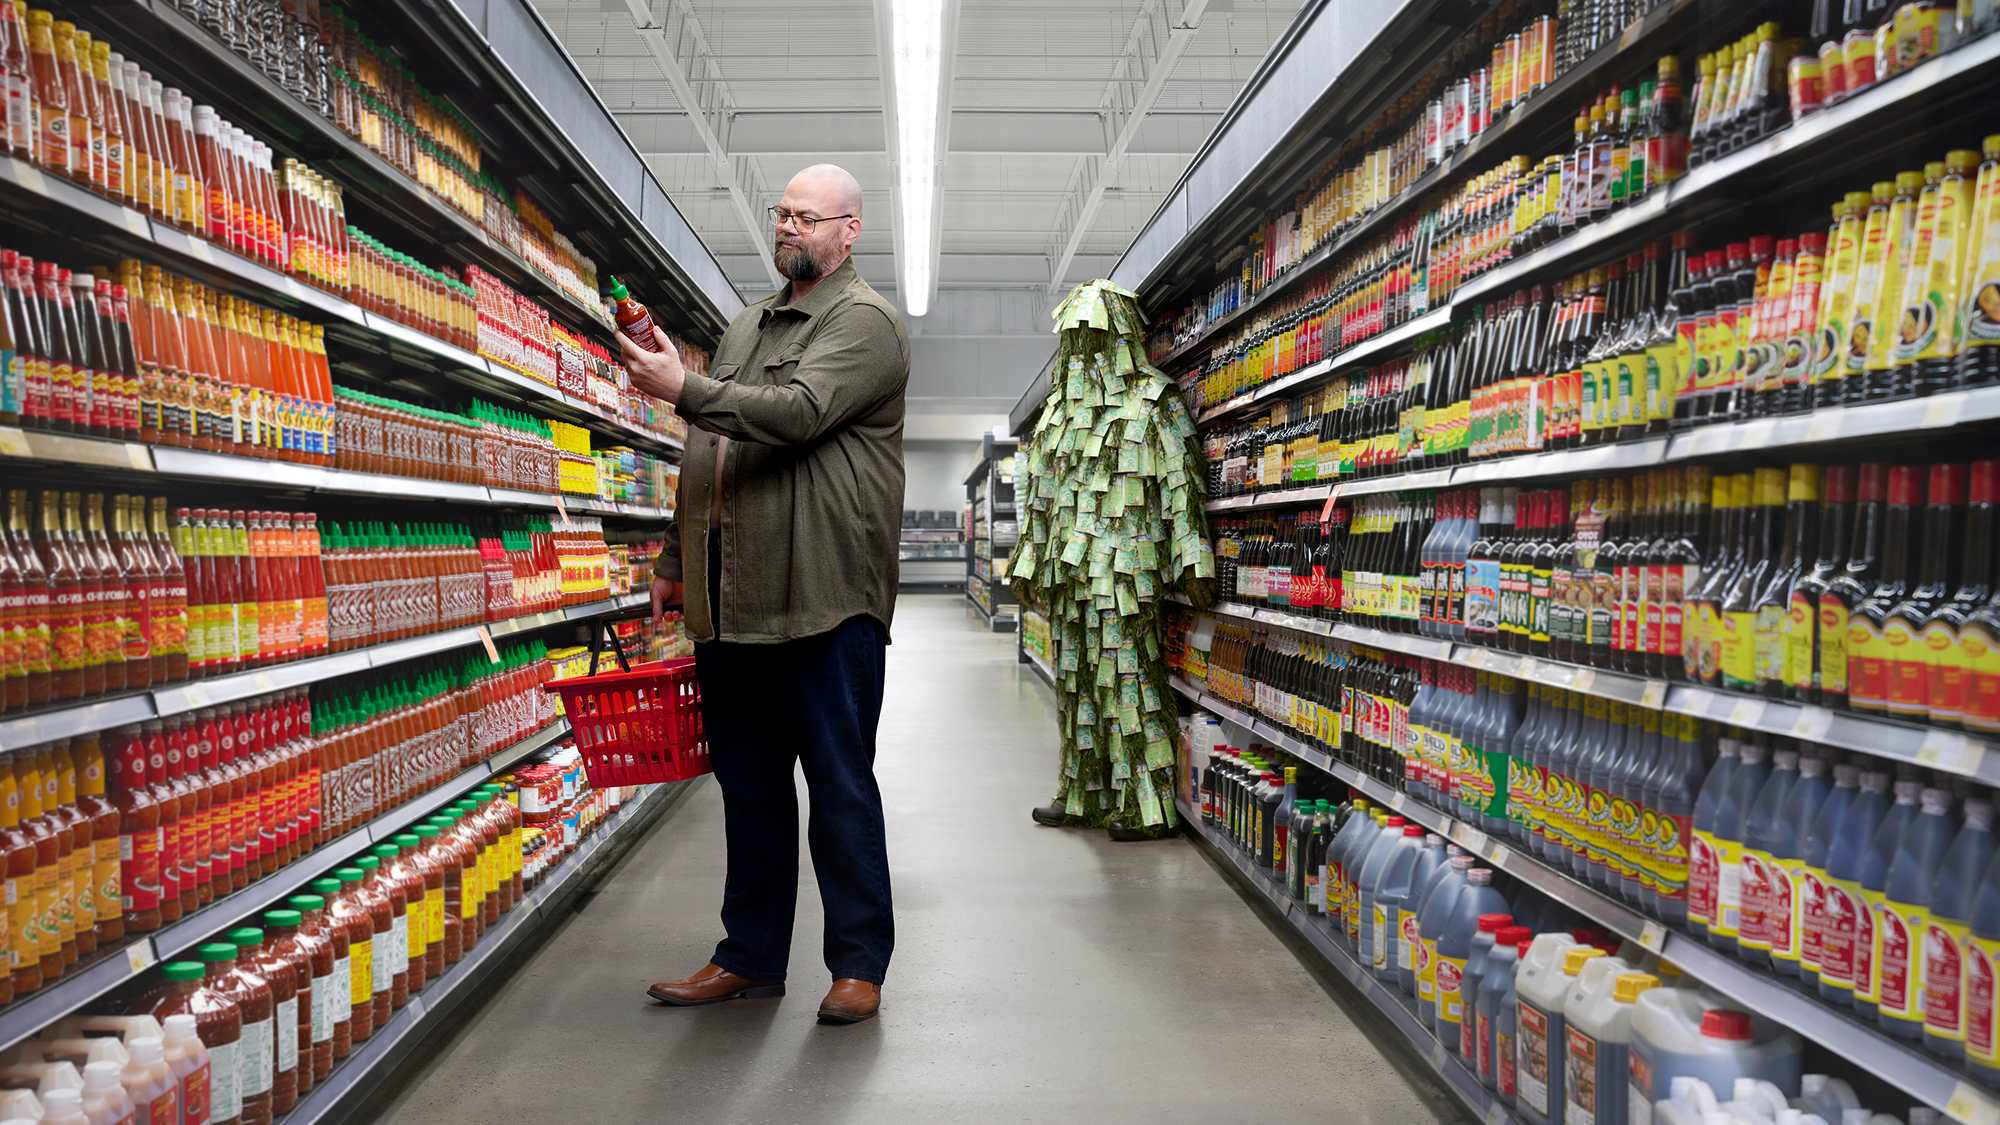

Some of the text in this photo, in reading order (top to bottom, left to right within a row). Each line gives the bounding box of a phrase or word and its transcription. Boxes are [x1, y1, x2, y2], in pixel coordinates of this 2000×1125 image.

[1074, 386, 1080, 395] 20
[1087, 396, 1093, 406] 20
[1120, 409, 1128, 417] 20
[1082, 415, 1089, 424] 20
[1100, 424, 1106, 433] 20
[1134, 430, 1141, 438] 20
[1172, 432, 1180, 440] 20
[1128, 459, 1134, 468] 20
[1037, 465, 1042, 473] 20
[1176, 473, 1183, 482] 20
[1047, 487, 1052, 495] 20
[1066, 493, 1071, 502] 20
[1128, 494, 1135, 503] 20
[1087, 500, 1093, 508] 20
[1108, 502, 1114, 511] 20
[1081, 520, 1087, 528] 20
[1181, 524, 1187, 533] 20
[1120, 538, 1127, 547] 20
[1190, 540, 1197, 549] 20
[1072, 553, 1079, 561] 20
[1191, 550, 1197, 560] 20
[1124, 561, 1131, 570] 20
[1143, 559, 1149, 567] 20
[1200, 566, 1206, 574] 20
[1145, 583, 1151, 592] 20
[1077, 589, 1083, 598] 20
[1122, 604, 1130, 613] 20
[1092, 614, 1097, 623] 20
[1088, 635, 1093, 644] 20
[1112, 635, 1119, 644] 20
[1068, 659, 1075, 667] 20
[1128, 660, 1134, 669] 20
[1099, 675, 1104, 684] 20
[1129, 695, 1136, 704] 20
[1154, 697, 1160, 706] 20
[1087, 713, 1094, 722] 20
[1124, 723, 1130, 734] 20
[1153, 728, 1160, 737] 20
[1083, 736, 1090, 745] 20
[1150, 758, 1157, 768] 20
[1071, 764, 1076, 774] 20
[1122, 765, 1128, 774] 20
[1068, 803, 1074, 813] 20
[1146, 814, 1153, 823] 20
